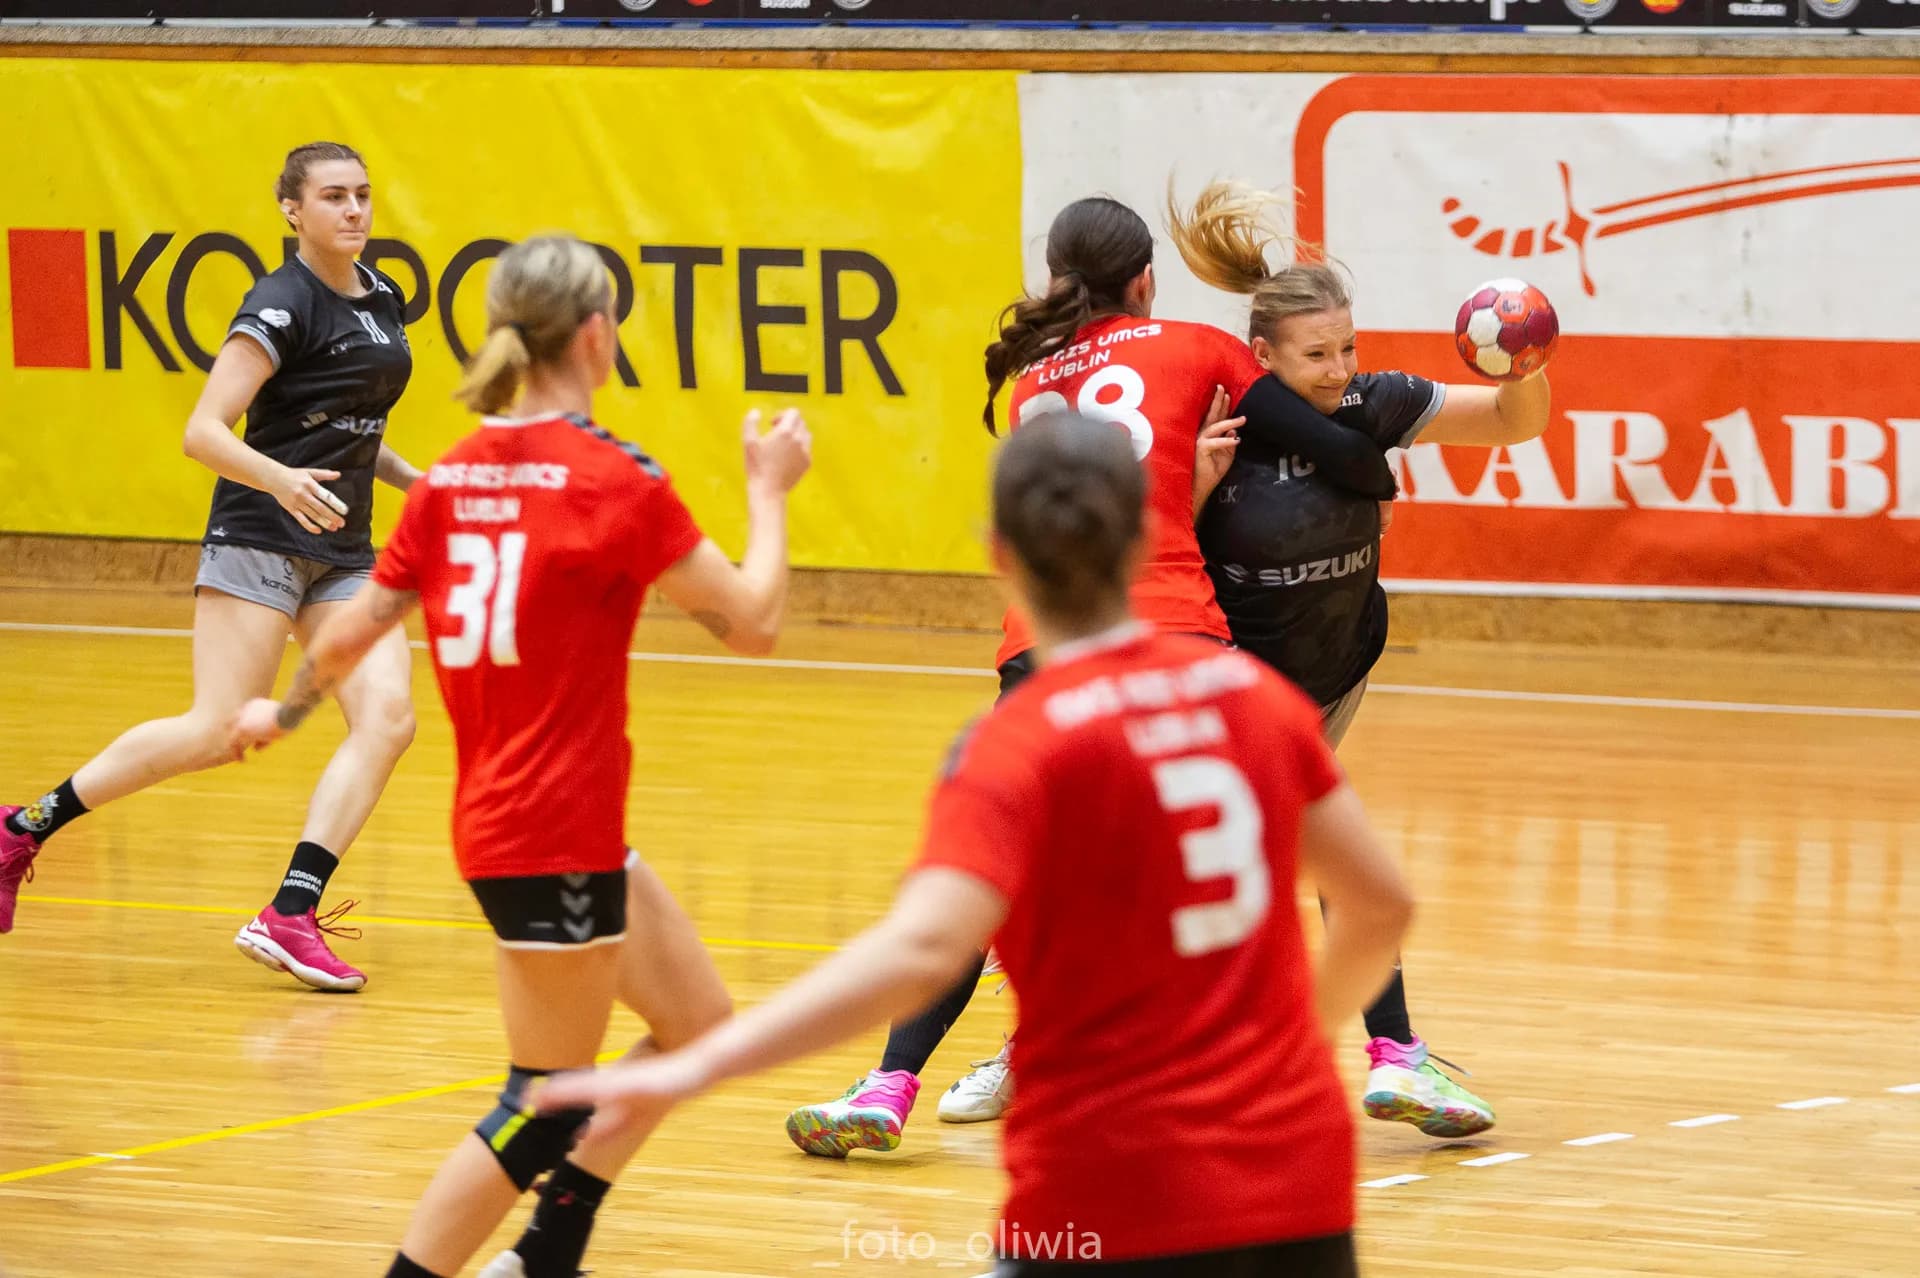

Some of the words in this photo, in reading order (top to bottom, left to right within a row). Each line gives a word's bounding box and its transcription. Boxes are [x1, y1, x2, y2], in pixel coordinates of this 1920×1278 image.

[1018, 364, 1154, 462] 8
[1038, 349, 1111, 385] LUBLIN
[437, 531, 528, 668] 31
[1258, 544, 1372, 586] SUZUKI
[1153, 756, 1271, 958] 3
